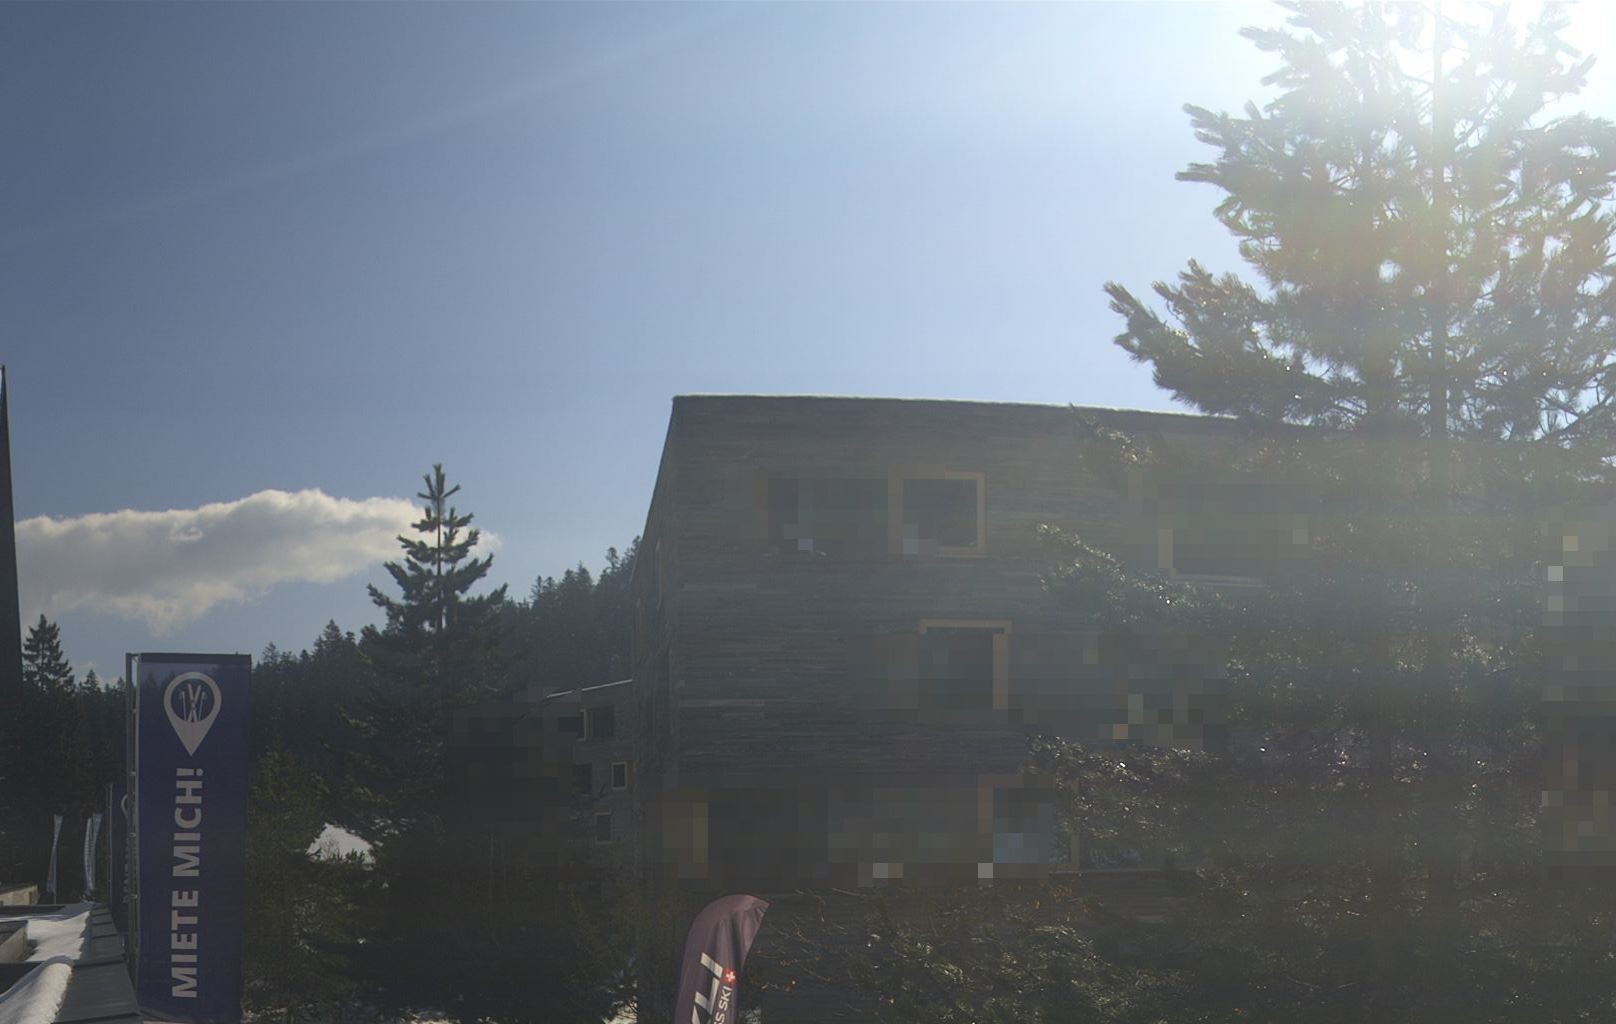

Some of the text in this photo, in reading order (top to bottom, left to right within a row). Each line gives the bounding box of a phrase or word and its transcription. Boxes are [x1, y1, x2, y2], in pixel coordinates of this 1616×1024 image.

[171, 766, 205, 999] MIETE MICH!
[718, 984, 733, 1013] SKI
